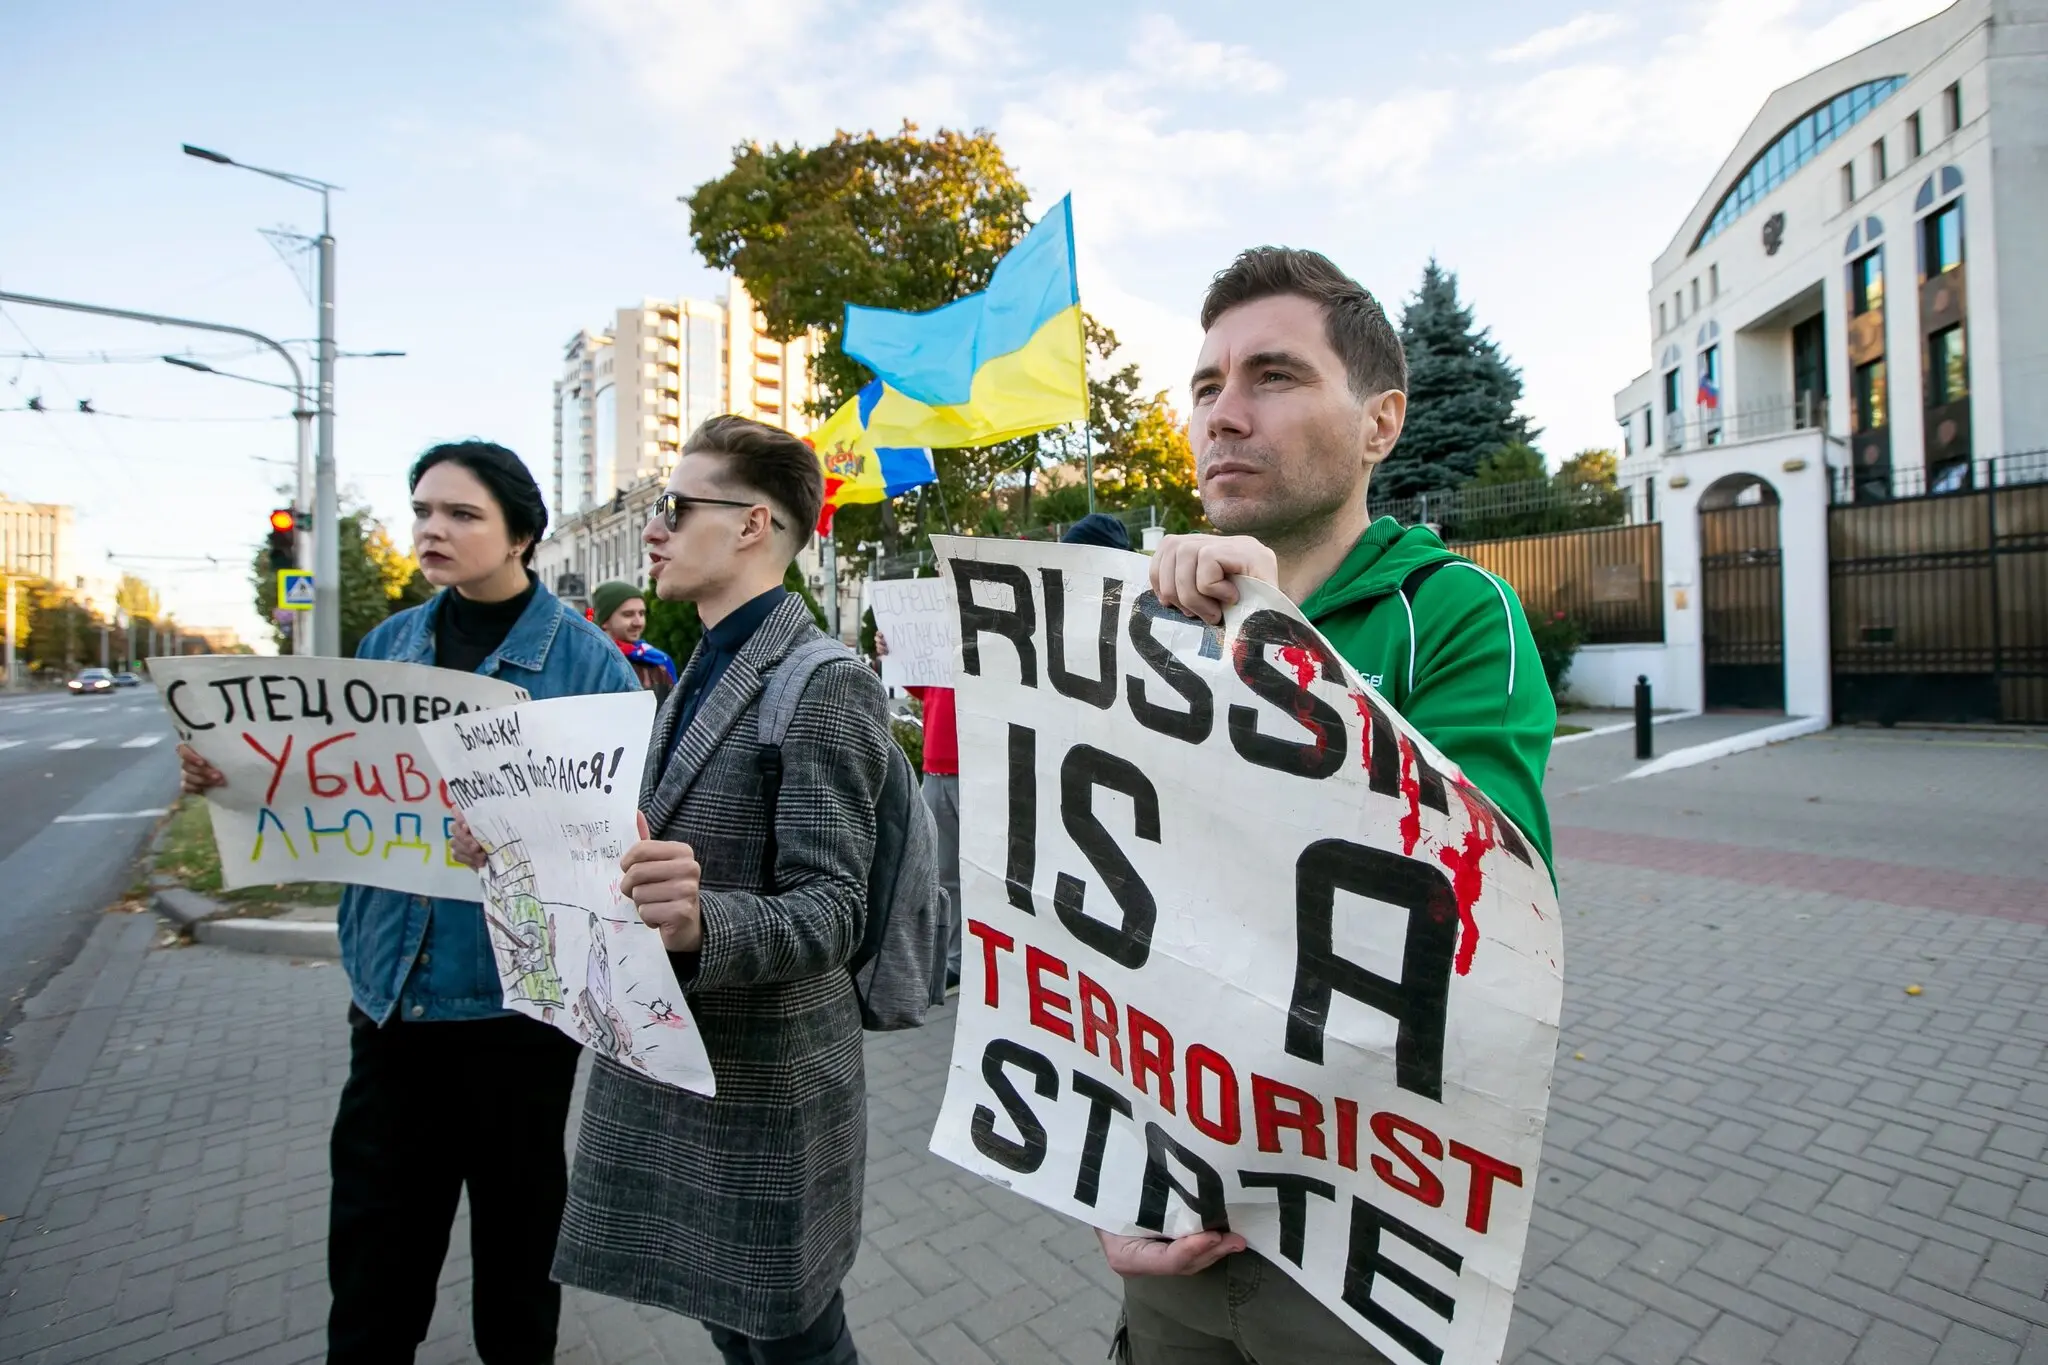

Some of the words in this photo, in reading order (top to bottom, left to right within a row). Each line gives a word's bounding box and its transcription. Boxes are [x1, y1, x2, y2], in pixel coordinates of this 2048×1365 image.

[968, 919, 1523, 1234] TERRORIST
[1004, 722, 1162, 971] IS
[1285, 838, 1459, 1104] A
[971, 1038, 1464, 1365] STATE
